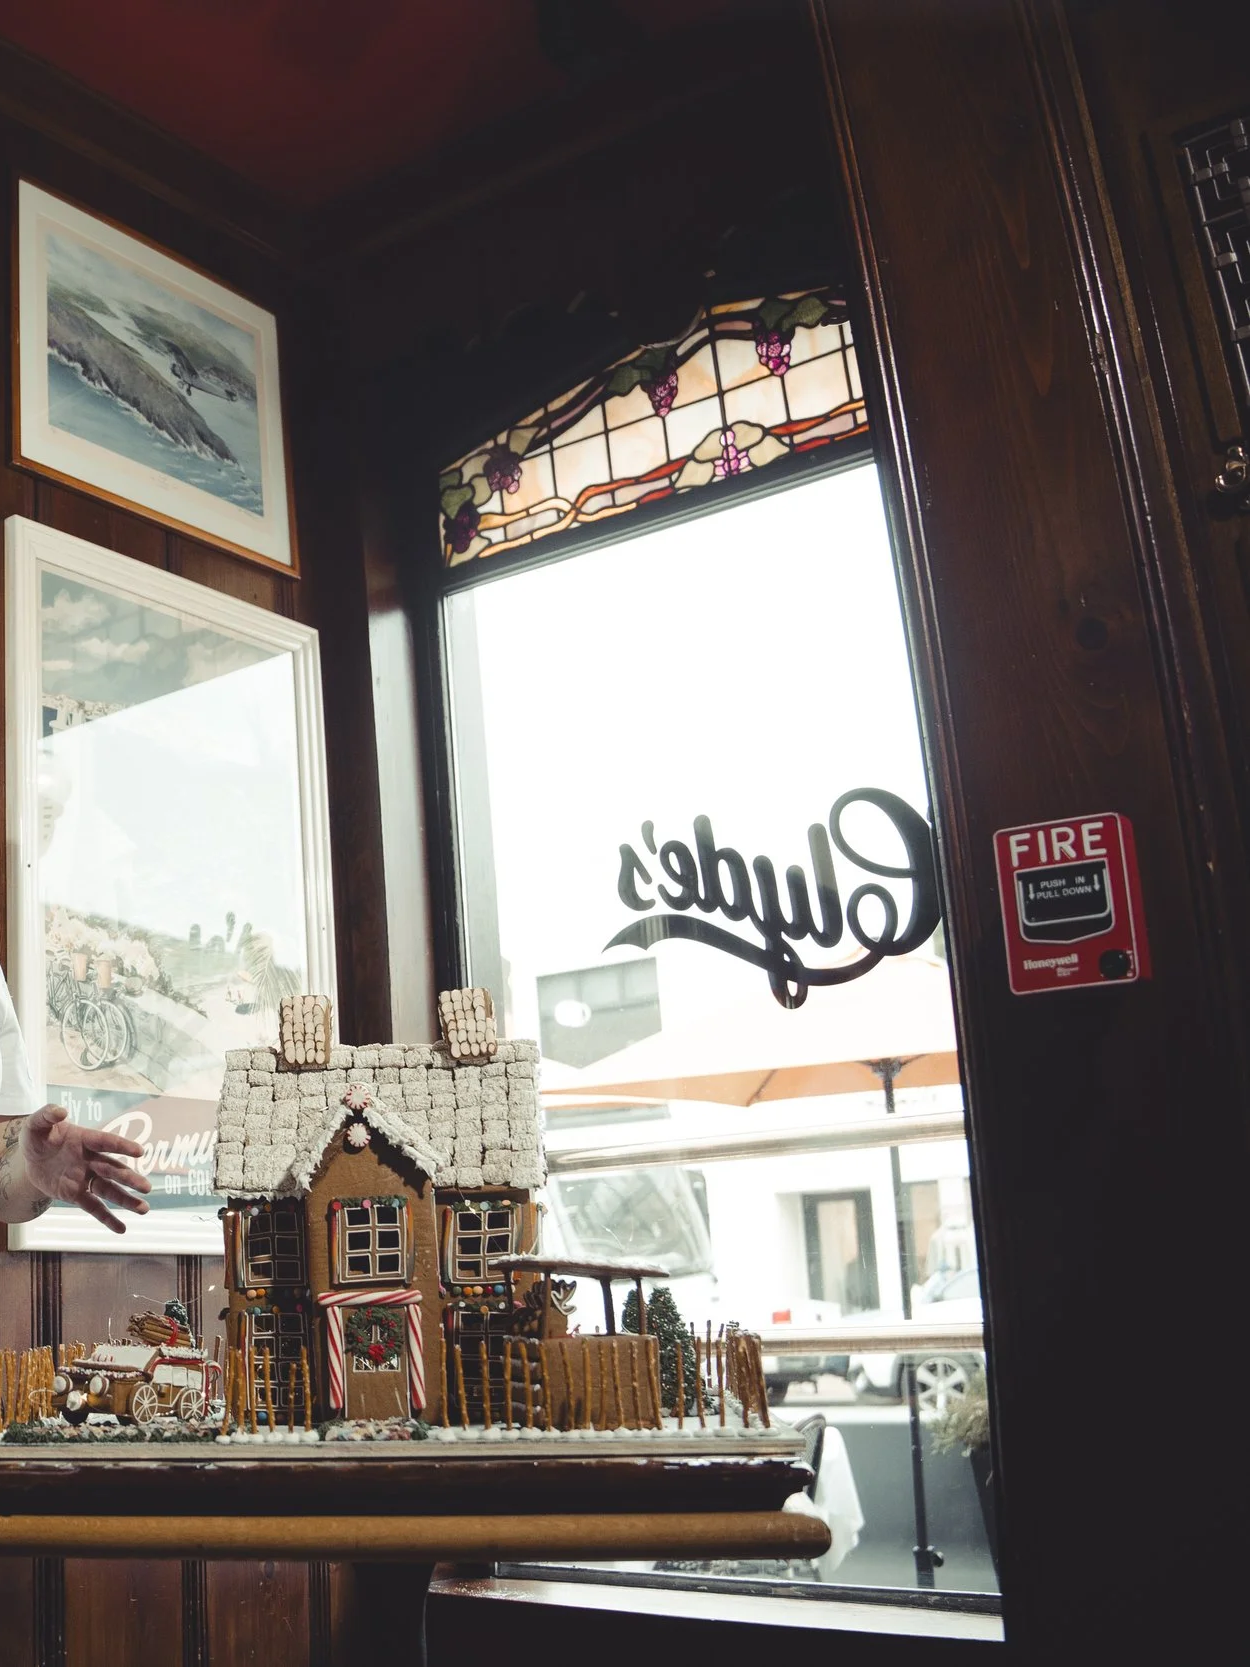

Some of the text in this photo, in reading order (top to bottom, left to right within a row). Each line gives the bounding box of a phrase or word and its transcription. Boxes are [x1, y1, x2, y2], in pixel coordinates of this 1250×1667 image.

[1008, 821, 1108, 868] FIRE
[1036, 885, 1093, 900] PULL DOWN
[1040, 875, 1086, 890] PUSH IN
[1022, 952, 1080, 971] Honeywell
[86, 1096, 103, 1122] to
[164, 1173, 182, 1195] on
